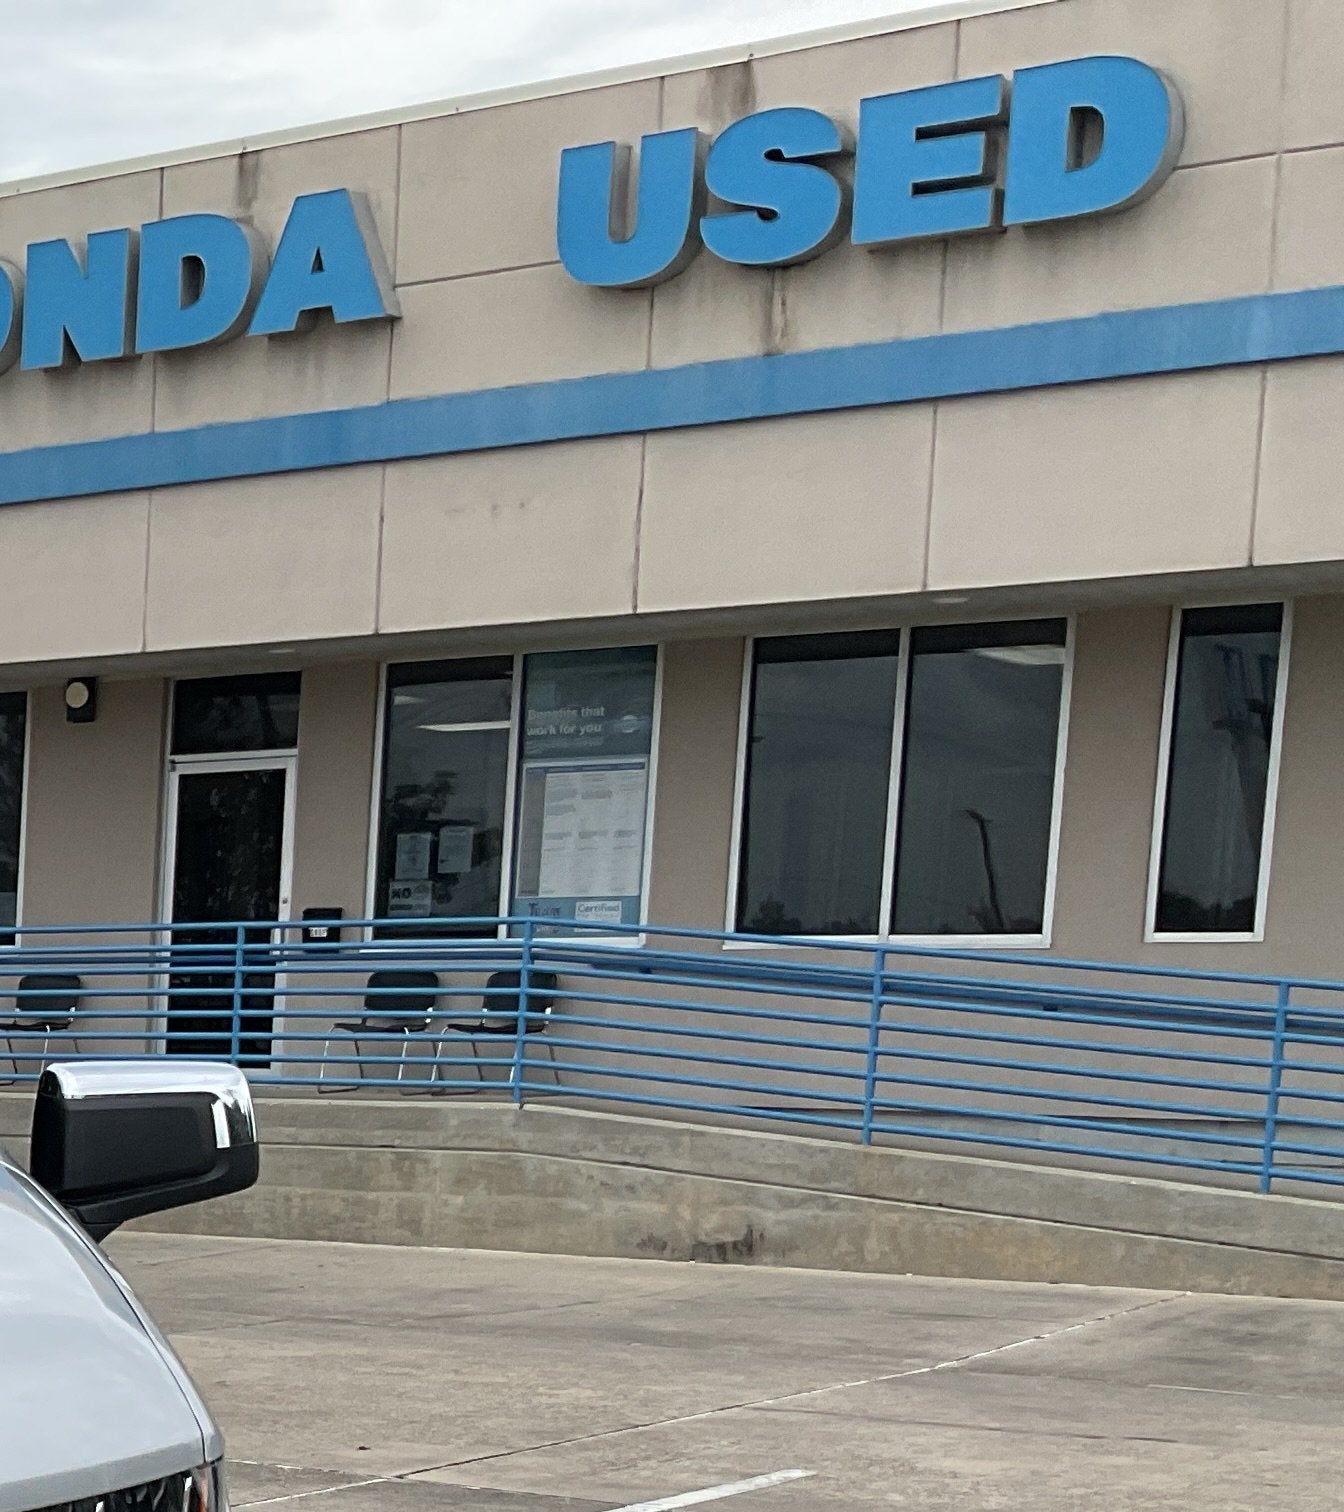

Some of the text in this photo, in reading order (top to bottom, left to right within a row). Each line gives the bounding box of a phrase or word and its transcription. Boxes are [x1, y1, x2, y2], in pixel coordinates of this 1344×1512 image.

[556, 55, 1182, 287] USED
[527, 723, 602, 736] work for you
